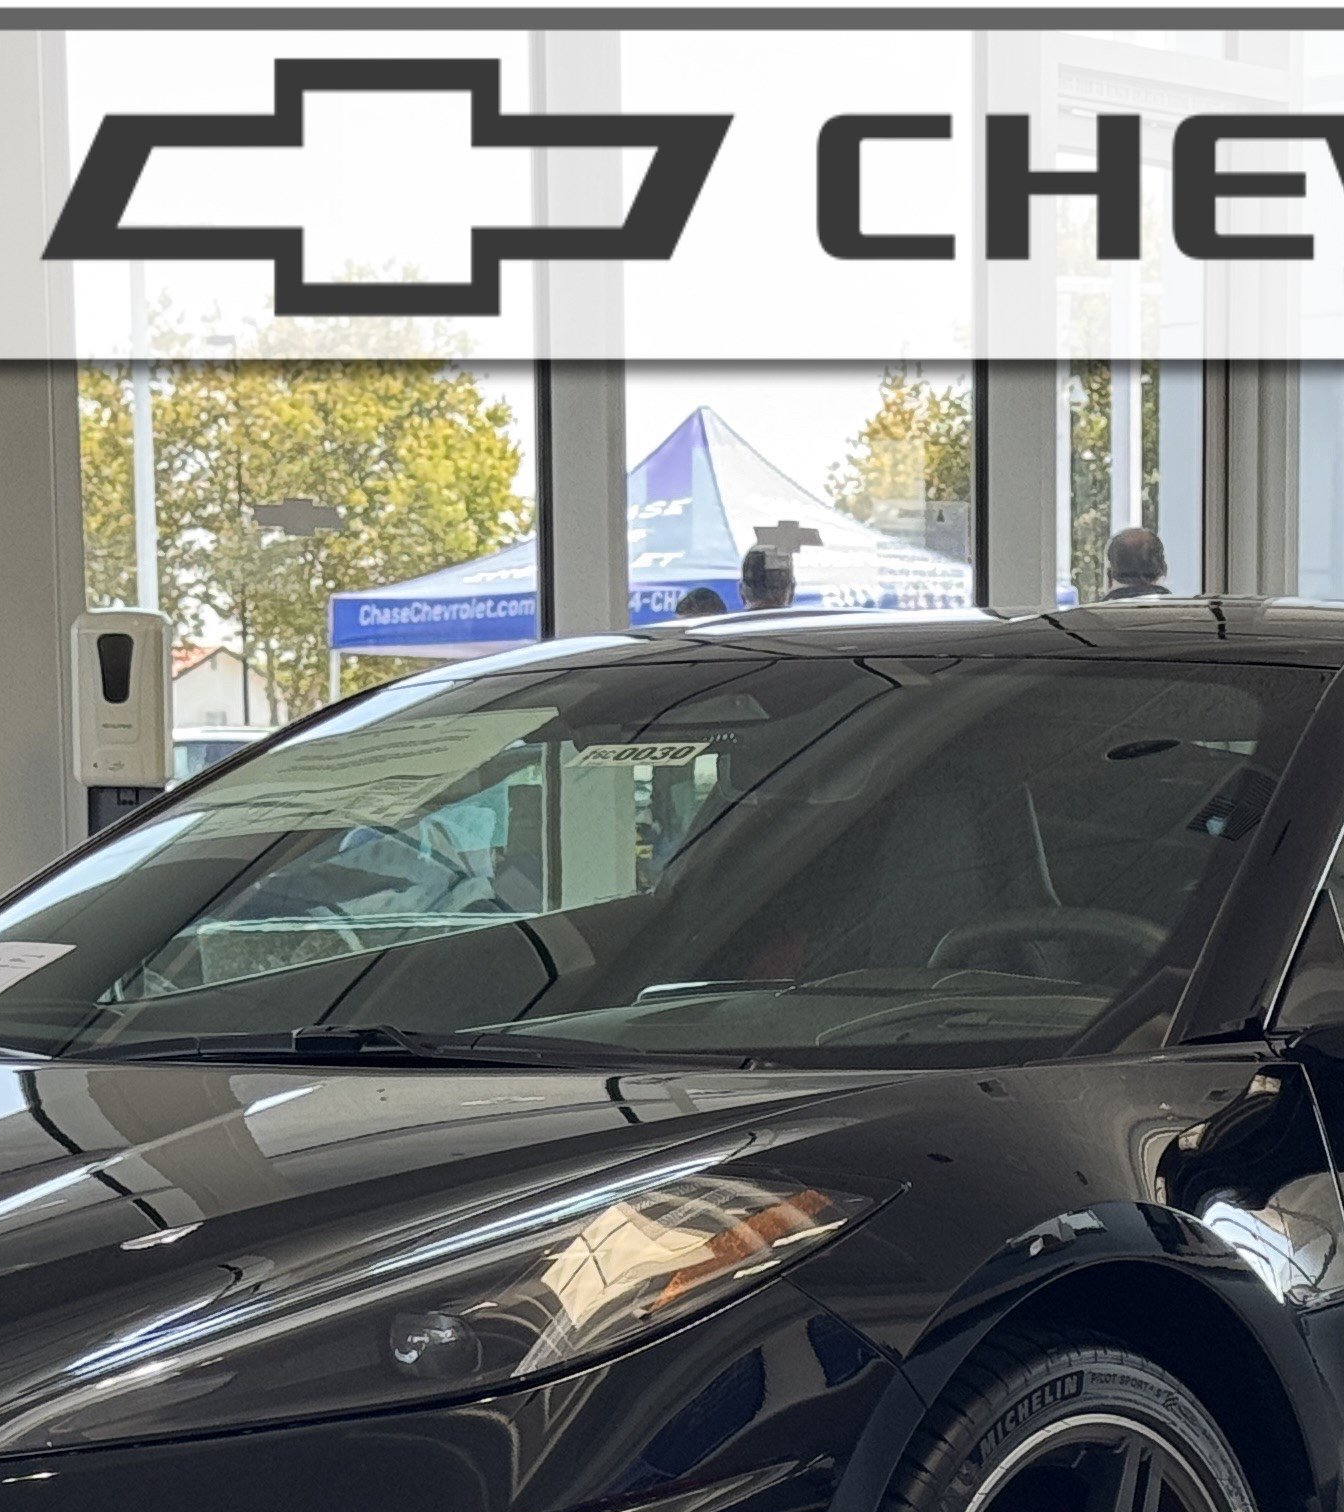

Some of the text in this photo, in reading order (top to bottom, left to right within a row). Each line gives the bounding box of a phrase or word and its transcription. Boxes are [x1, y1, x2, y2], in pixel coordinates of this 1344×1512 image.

[359, 599, 535, 626] ChaseChevrolet.com
[979, 1373, 1081, 1465] MICHELIN
[1090, 1372, 1117, 1385] PILOT
[1119, 1374, 1149, 1392] SPORT
